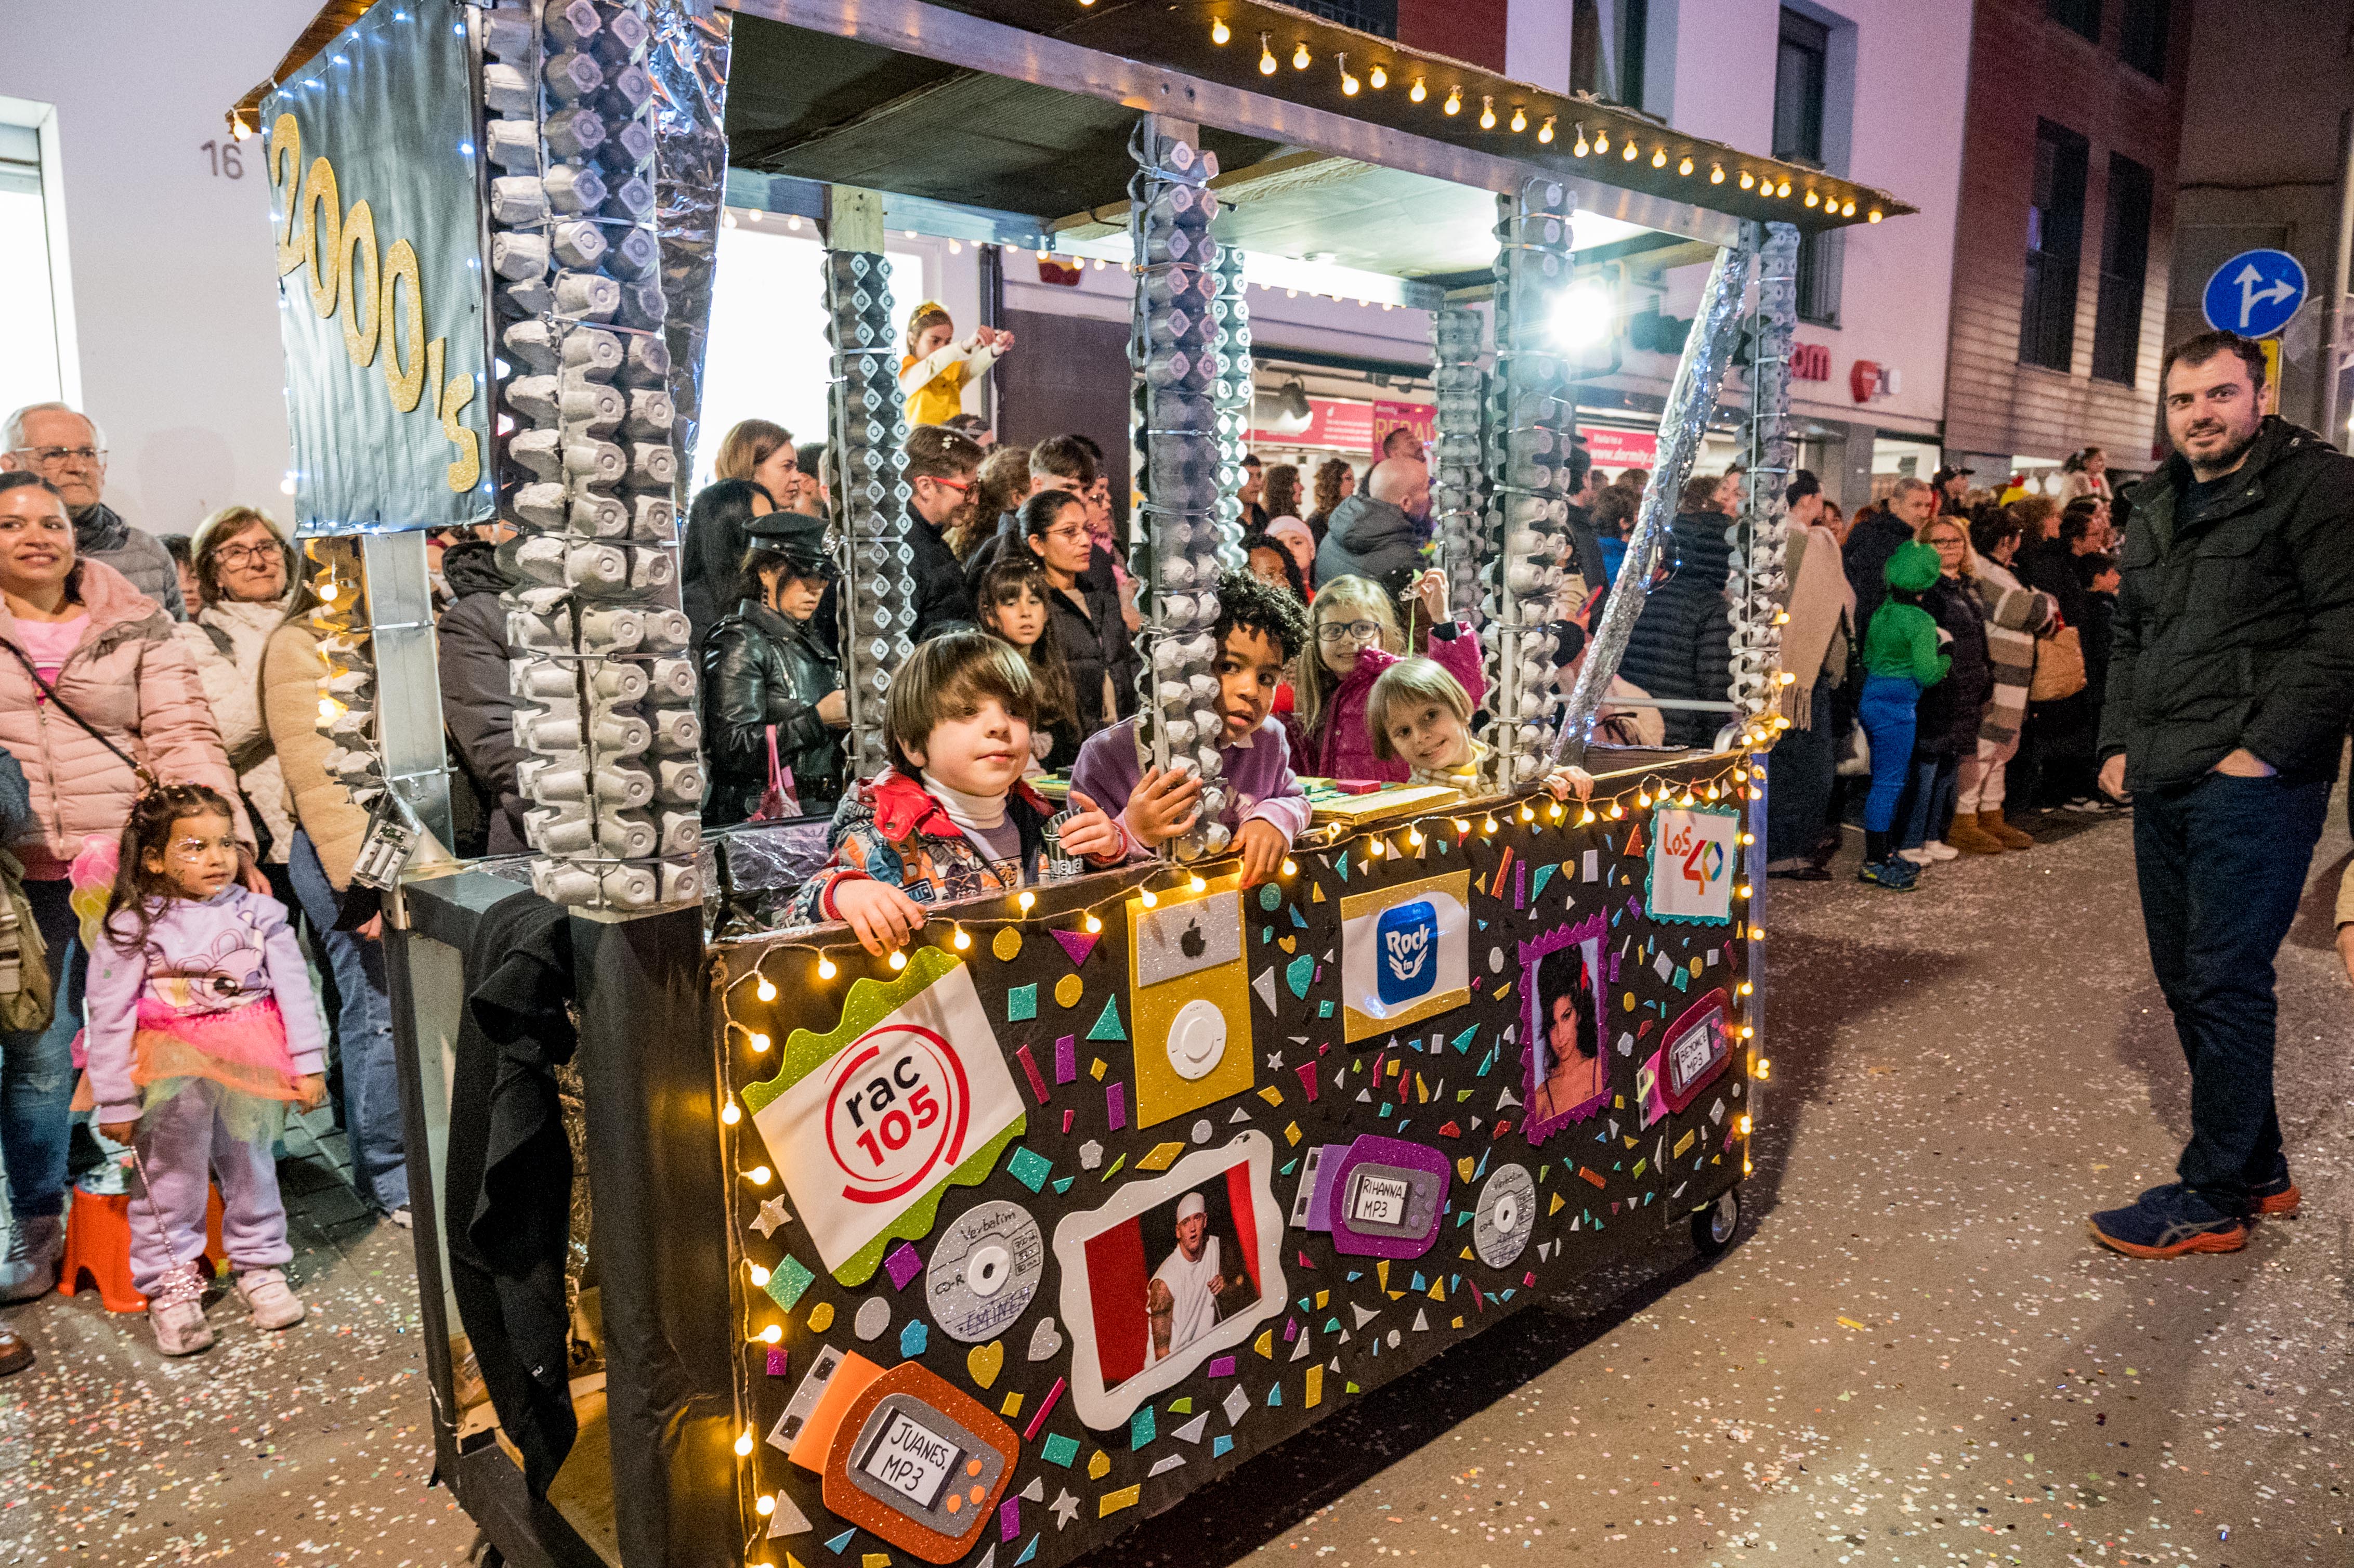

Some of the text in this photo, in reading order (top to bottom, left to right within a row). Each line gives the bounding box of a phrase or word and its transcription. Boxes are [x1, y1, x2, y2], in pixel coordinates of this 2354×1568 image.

[200, 140, 243, 179] 16
[270, 113, 480, 493] 2000's
[1683, 840, 1724, 896] 40
[1385, 923, 1430, 961] Rock
[1403, 960, 1414, 971] fm
[1686, 1052, 1703, 1079] MP3
[846, 1056, 920, 1128] rac
[856, 1083, 939, 1167] 105
[960, 1212, 1015, 1240] Verbatim
[1363, 1200, 1388, 1218] MP3
[936, 1274, 964, 1295] CD-R
[881, 1454, 924, 1491] MP3
